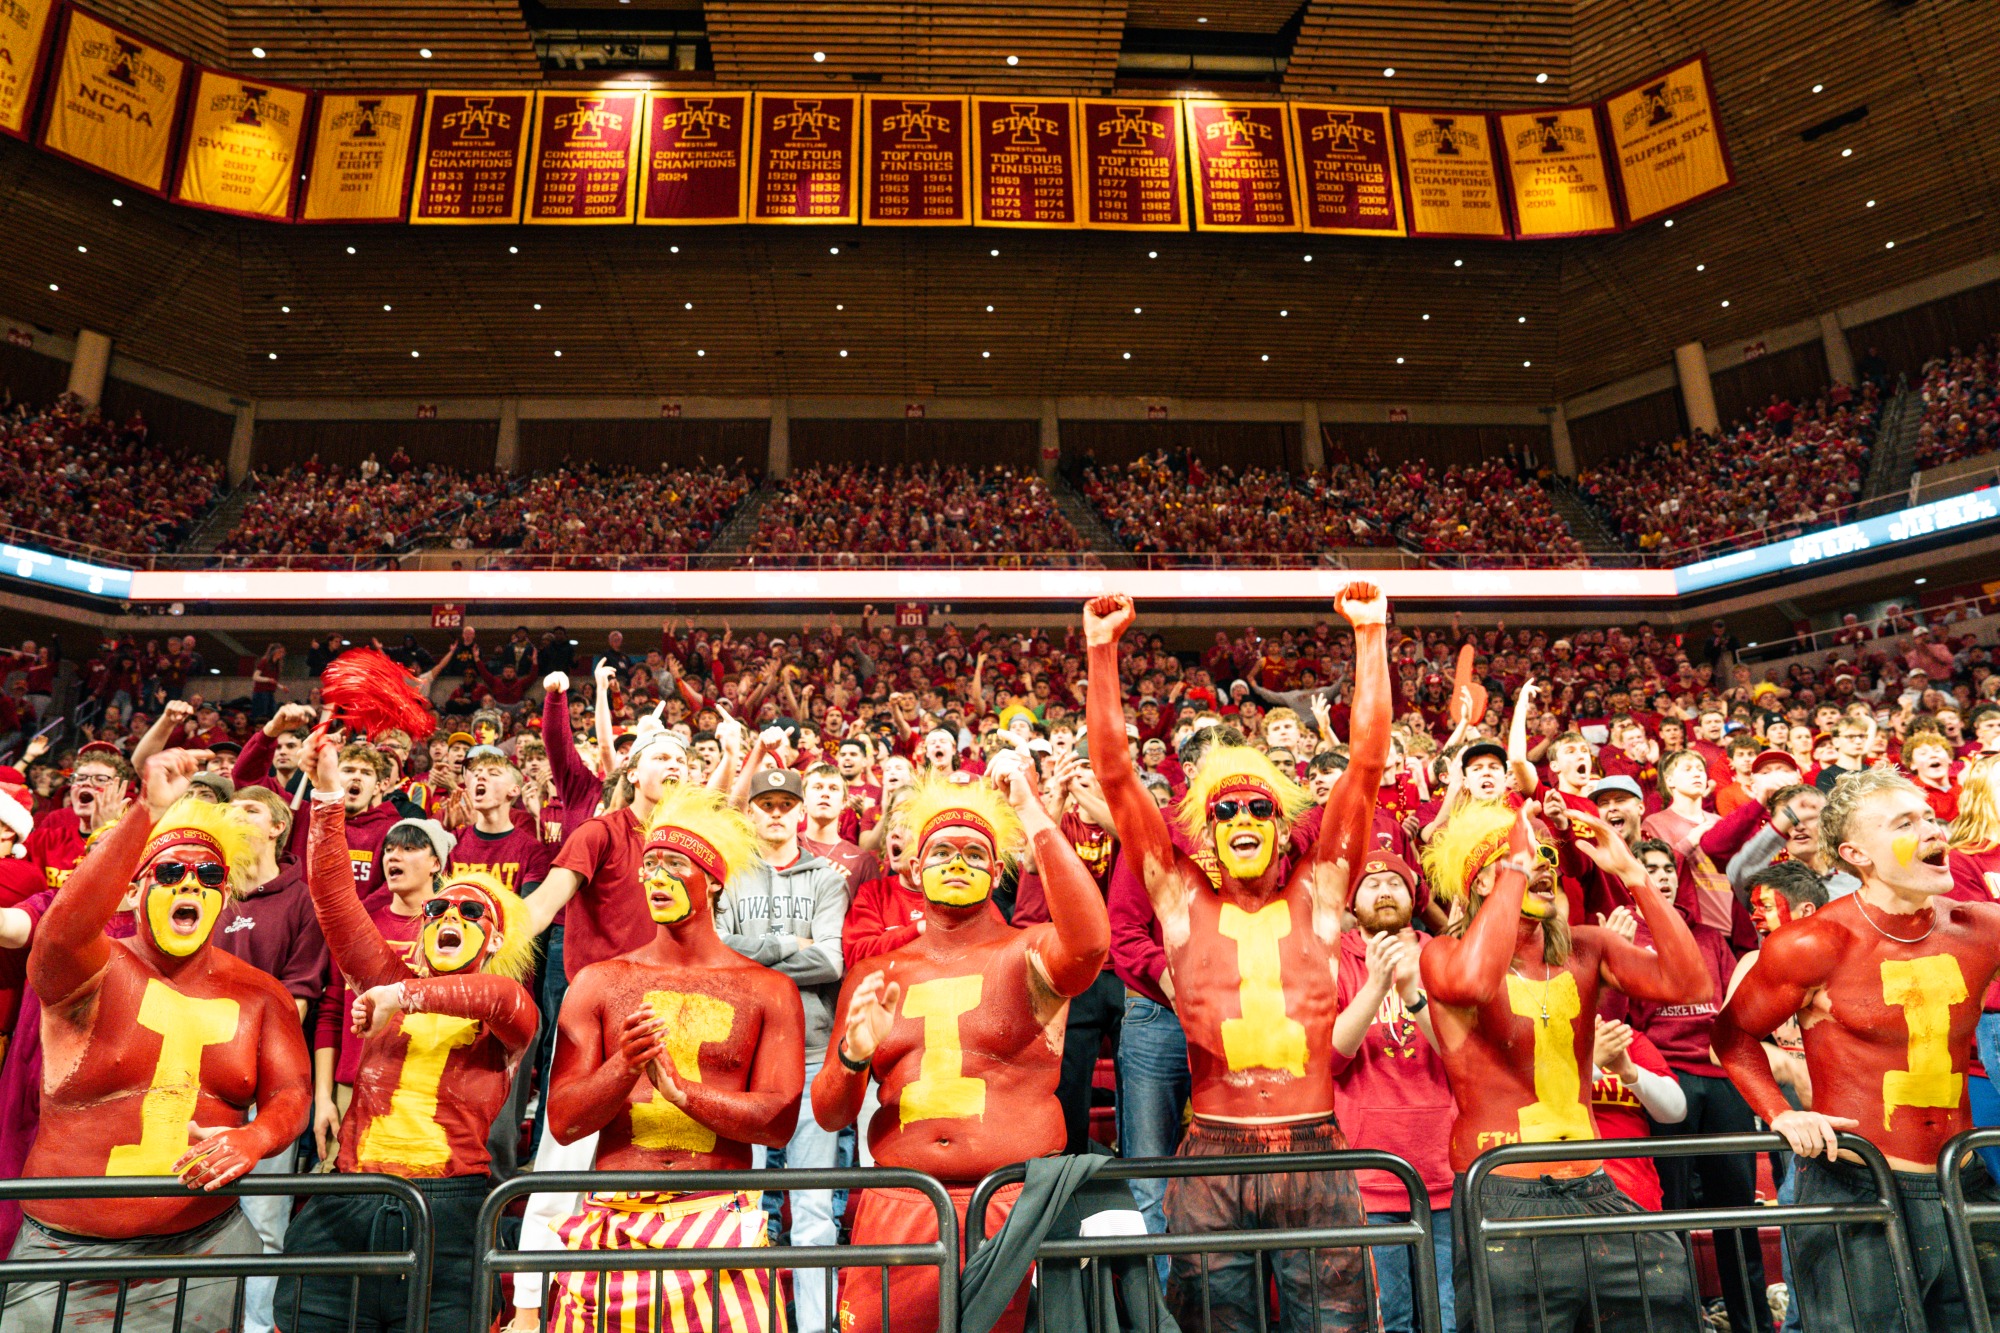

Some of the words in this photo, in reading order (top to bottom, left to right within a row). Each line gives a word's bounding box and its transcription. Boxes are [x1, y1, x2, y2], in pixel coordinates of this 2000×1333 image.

[79, 84, 152, 127] NCAA
[442, 110, 511, 129] STATE
[554, 111, 623, 130] STATE
[663, 111, 731, 130] STATE
[773, 112, 840, 131] STATE
[882, 114, 950, 132] STATE
[992, 117, 1059, 136] STATE
[1098, 119, 1165, 139] STATE
[1206, 121, 1272, 140] STATE
[1312, 124, 1376, 144] STATE
[1414, 128, 1479, 149] STATE
[1517, 126, 1586, 149] STATE
[198, 136, 265, 158] SWEET
[1624, 138, 1677, 167] SUPER
[1682, 122, 1709, 142] SIX
[339, 152, 382, 160] ELITE
[432, 150, 512, 158] CONFERENCE
[545, 151, 624, 159] CONFERENCE
[655, 151, 734, 159] CONFERENCE
[770, 150, 799, 159] TOP
[803, 150, 842, 159] FOUR
[881, 152, 910, 160] TOP
[914, 152, 953, 160] FOUR
[991, 154, 1019, 163] TOP
[1024, 154, 1062, 164] FOUR
[337, 160, 382, 169] EIGHT
[429, 159, 513, 168] CHAMPIONS
[543, 160, 625, 169] CHAMPIONS
[653, 159, 736, 169] CHAMPIONS
[770, 161, 841, 169] FINISHES
[881, 162, 953, 171] FINISHES
[1098, 156, 1127, 166] TOP
[1131, 157, 1169, 167] FOUR
[1209, 158, 1237, 168] TOP
[1240, 159, 1278, 168] FOUR
[1314, 160, 1341, 170] TOP
[1345, 162, 1383, 172] FOUR
[991, 164, 1062, 174] FINISHES
[1098, 167, 1169, 177] FINISHES
[1209, 168, 1279, 178] FINISHES
[1414, 168, 1488, 177] CONFERENCE
[1536, 164, 1577, 175] NCAA
[432, 172, 464, 180] 1933
[475, 172, 506, 180] 1937
[546, 172, 577, 180] 1977
[588, 172, 619, 180] 1979
[657, 173, 688, 181] 2024
[880, 174, 909, 182] 1960
[924, 174, 952, 182] 1961
[991, 176, 1020, 184] 1969
[1034, 177, 1063, 185] 1970
[1315, 171, 1384, 182] FINISHES
[1535, 174, 1583, 185] FINALS
[431, 183, 462, 191] 1941
[473, 183, 505, 191] 1942
[1098, 179, 1127, 187] 1977
[1414, 177, 1491, 187] CHAMPIONS
[767, 184, 797, 192] 1931
[880, 185, 909, 193] 1963
[924, 185, 953, 193] 1964
[991, 187, 1020, 195] 1971
[1034, 188, 1063, 196] 1972
[429, 194, 461, 202] 1947
[586, 195, 617, 203] 2007
[766, 195, 796, 203] 1933
[1461, 190, 1486, 198] 1977
[991, 199, 1020, 207] 1973
[1034, 200, 1064, 208] 1974
[1212, 203, 1241, 211] 1992
[427, 206, 460, 214] 1970
[471, 206, 502, 214] 1976
[880, 208, 909, 216] 1967
[991, 210, 1021, 218] 1975
[1035, 211, 1064, 219] 1976
[1319, 205, 1346, 214] 2010
[1360, 207, 1389, 215] 2024
[1213, 214, 1242, 222] 1997
[435, 614, 461, 627] 142
[901, 613, 923, 626] 101
[668, 831, 716, 868] STATE
[738, 895, 770, 923] OWA
[772, 895, 816, 921] STAT
[1655, 1003, 1720, 1017] BASKETBALL
[1477, 1131, 1517, 1150] FTH
